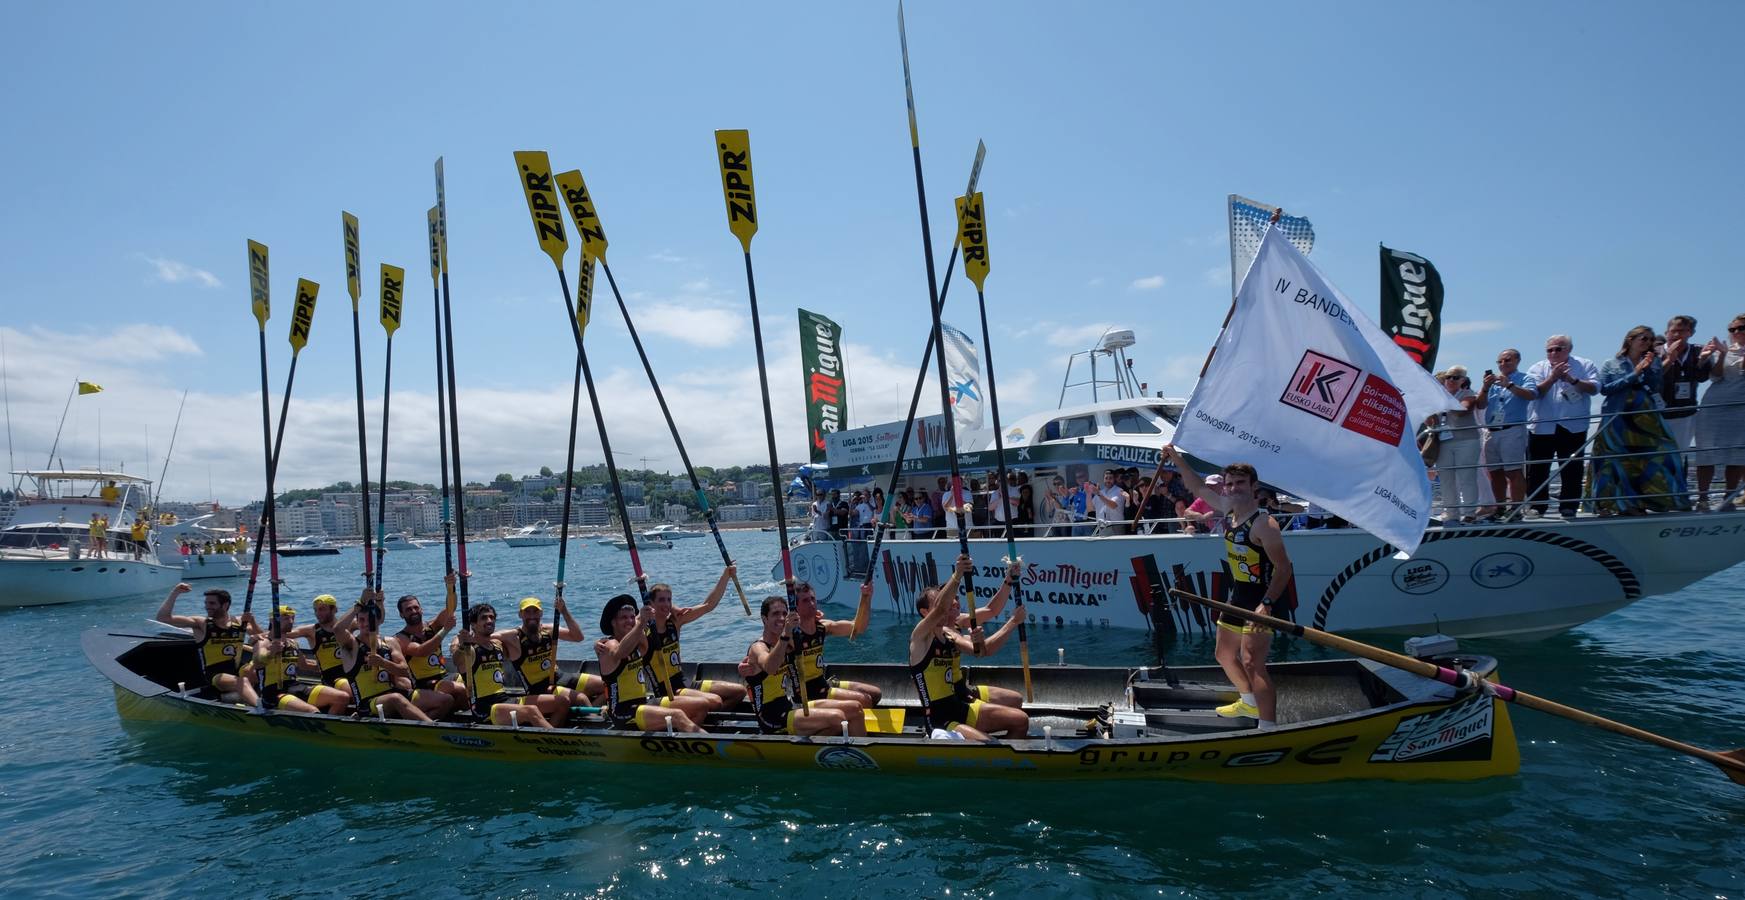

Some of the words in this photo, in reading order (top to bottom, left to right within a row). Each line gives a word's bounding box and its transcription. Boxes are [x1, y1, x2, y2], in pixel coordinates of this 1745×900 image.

[1275, 277, 1292, 294] IV
[1294, 288, 1359, 332] BANDE
[1286, 392, 1312, 408] EUSKO
[1311, 402, 1335, 417] LABEL
[842, 437, 857, 447] LIGA
[858, 434, 873, 445] 2015
[1196, 410, 1236, 435] DONOSTIA
[1238, 430, 1281, 454] 2015-07-12
[1097, 445, 1182, 466] HEGALUZE.C
[1374, 486, 1392, 501] LIGA
[983, 565, 1009, 579] 201
[958, 584, 1013, 601] CRO
[1048, 591, 1108, 607] CAIXA"
[640, 738, 715, 757] ORIO
[1079, 749, 1222, 766] grupo
